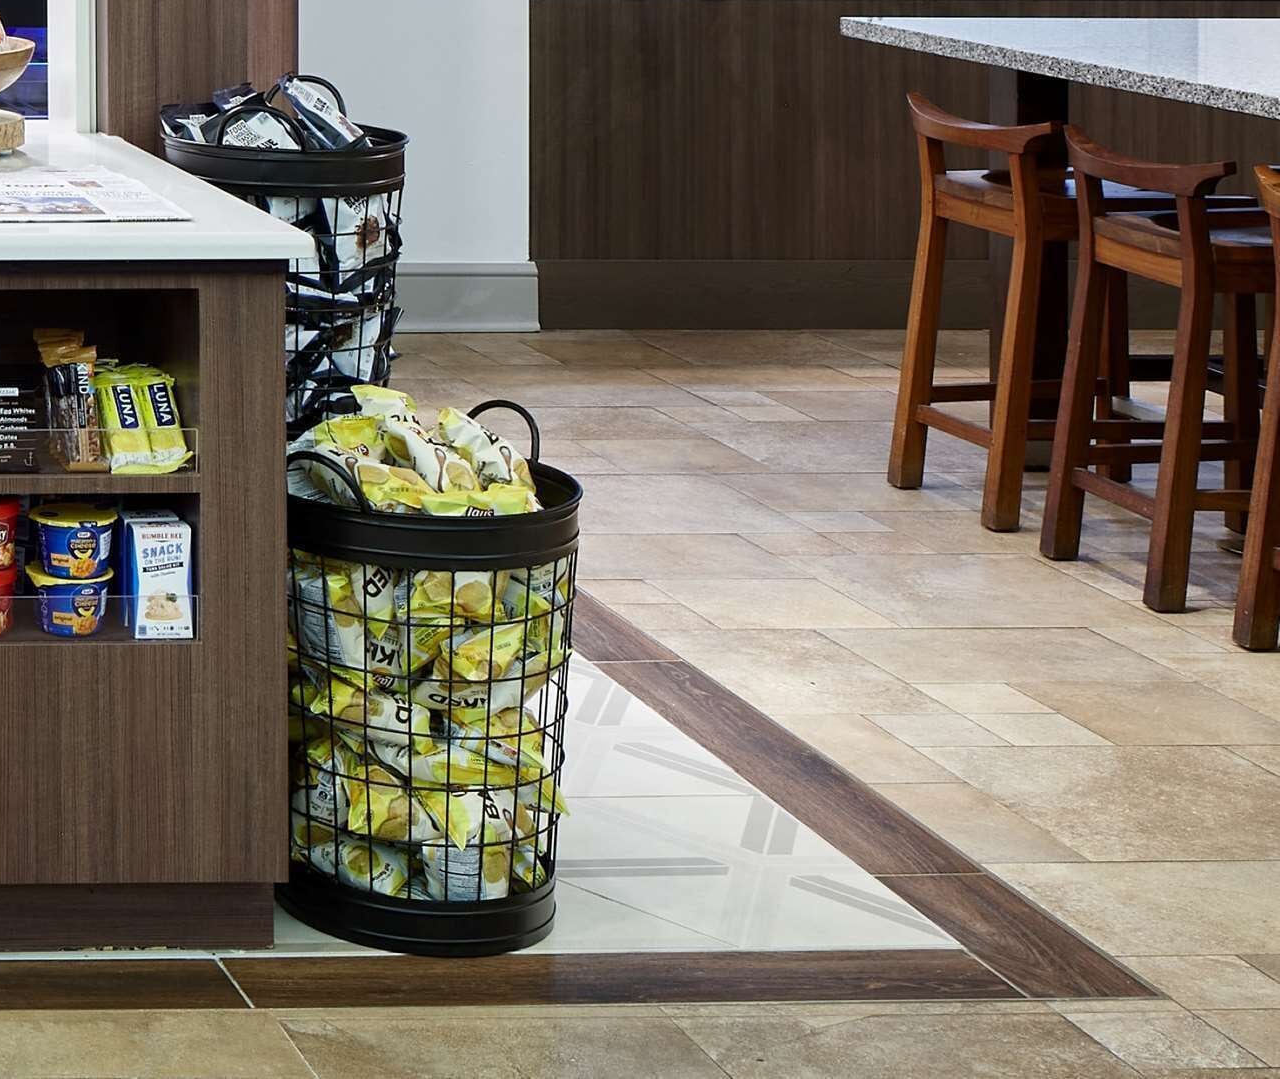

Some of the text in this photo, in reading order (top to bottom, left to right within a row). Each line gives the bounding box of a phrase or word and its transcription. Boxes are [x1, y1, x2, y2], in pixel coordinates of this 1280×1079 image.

[77, 363, 89, 394] KIND
[116, 385, 136, 426] LUNA
[153, 384, 172, 423] LUNA
[142, 543, 183, 559] SNACK
